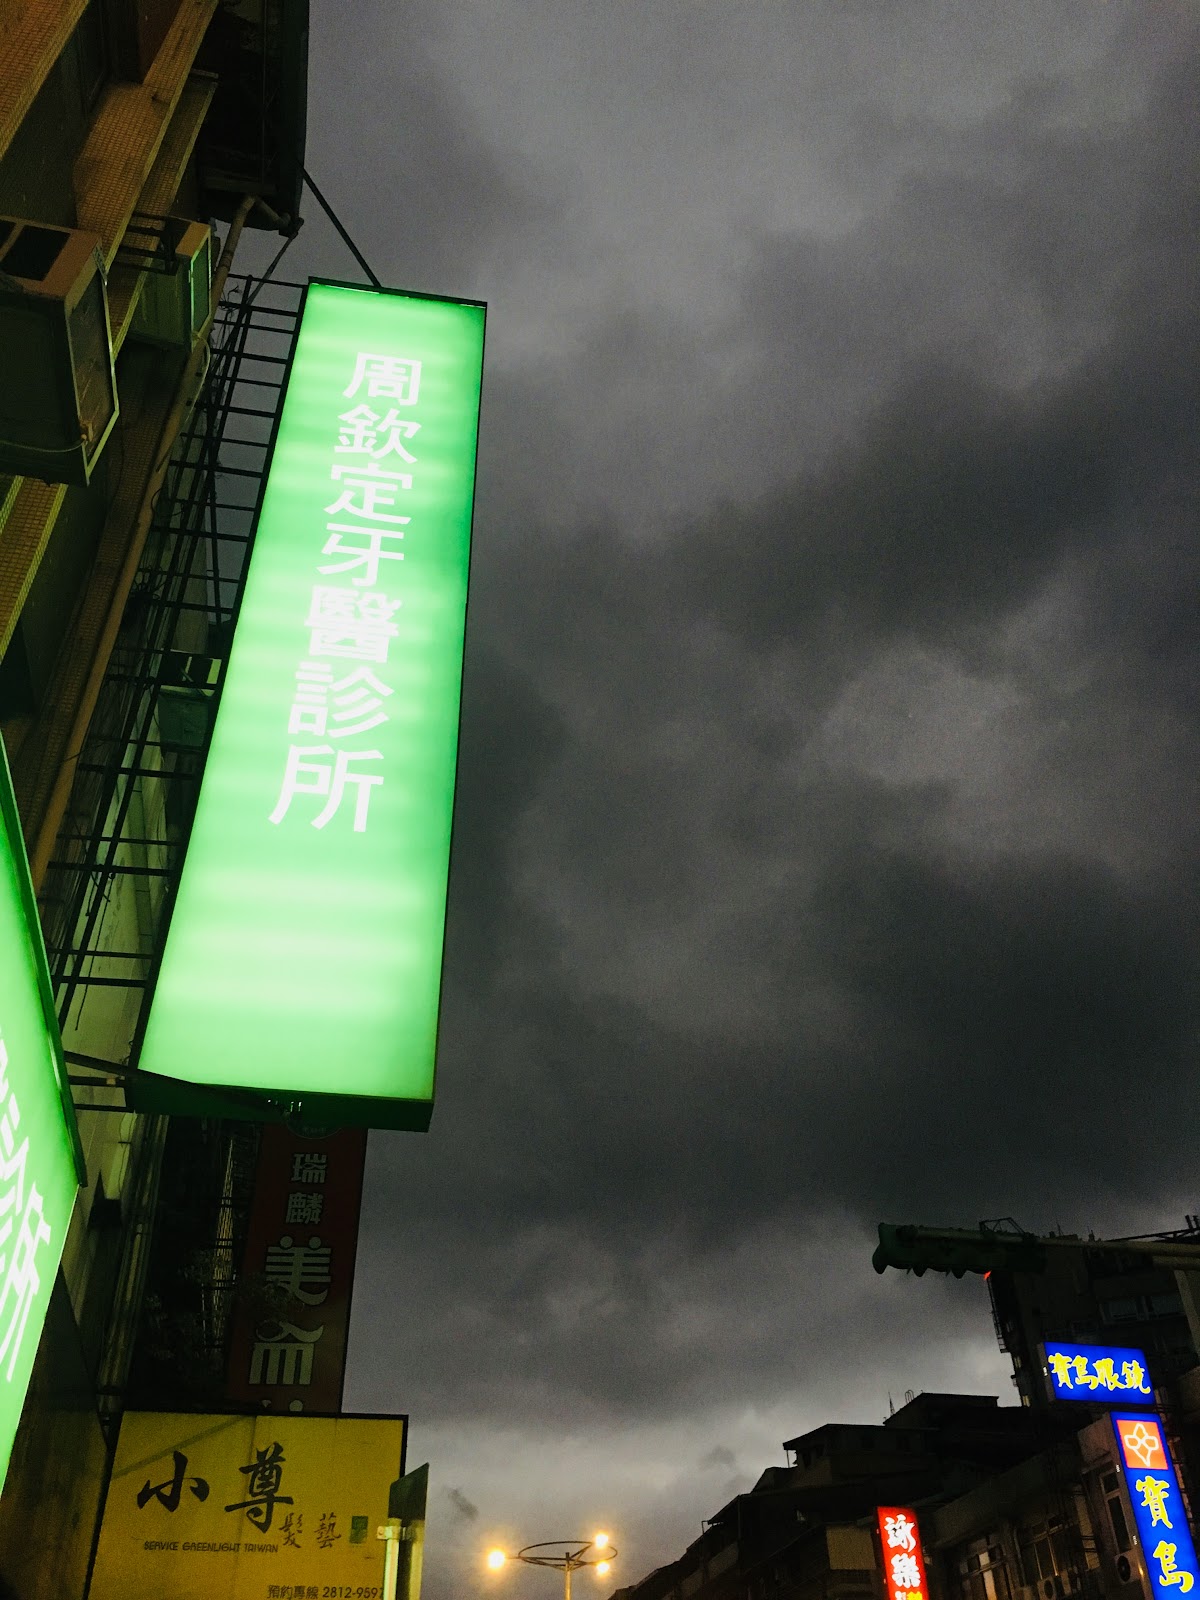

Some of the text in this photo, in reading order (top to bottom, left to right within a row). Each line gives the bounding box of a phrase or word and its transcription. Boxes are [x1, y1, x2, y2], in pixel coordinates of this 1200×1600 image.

[267, 351, 423, 834] 周欽定牙醫診所
[1048, 1353, 1151, 1394] 寶島眼鏡
[244, 1543, 279, 1553] TAIWAN
